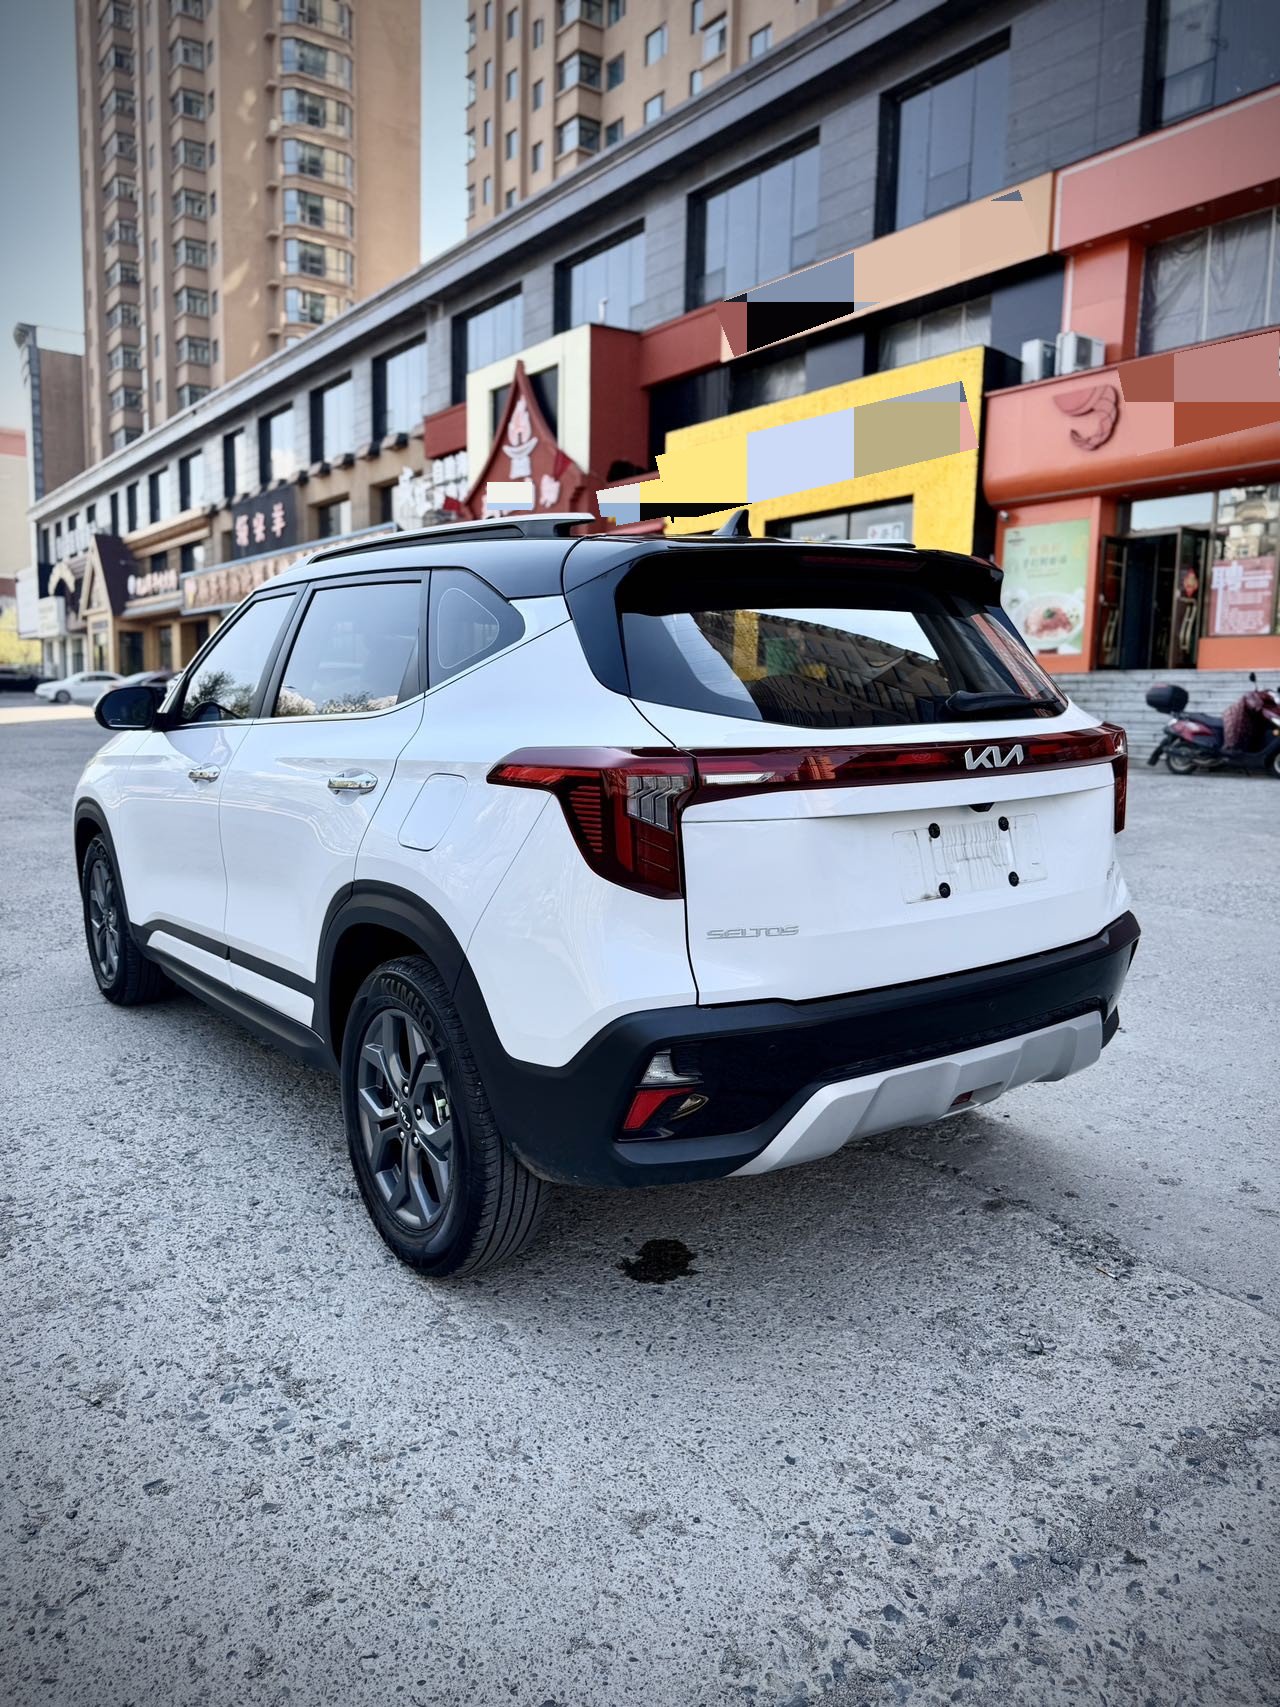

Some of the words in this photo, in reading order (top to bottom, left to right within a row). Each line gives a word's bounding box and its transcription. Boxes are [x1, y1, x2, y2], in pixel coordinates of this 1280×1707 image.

[964, 743, 1024, 770] KIA
[705, 925, 800, 940] SELTOS
[381, 978, 434, 1037] KUMHO
